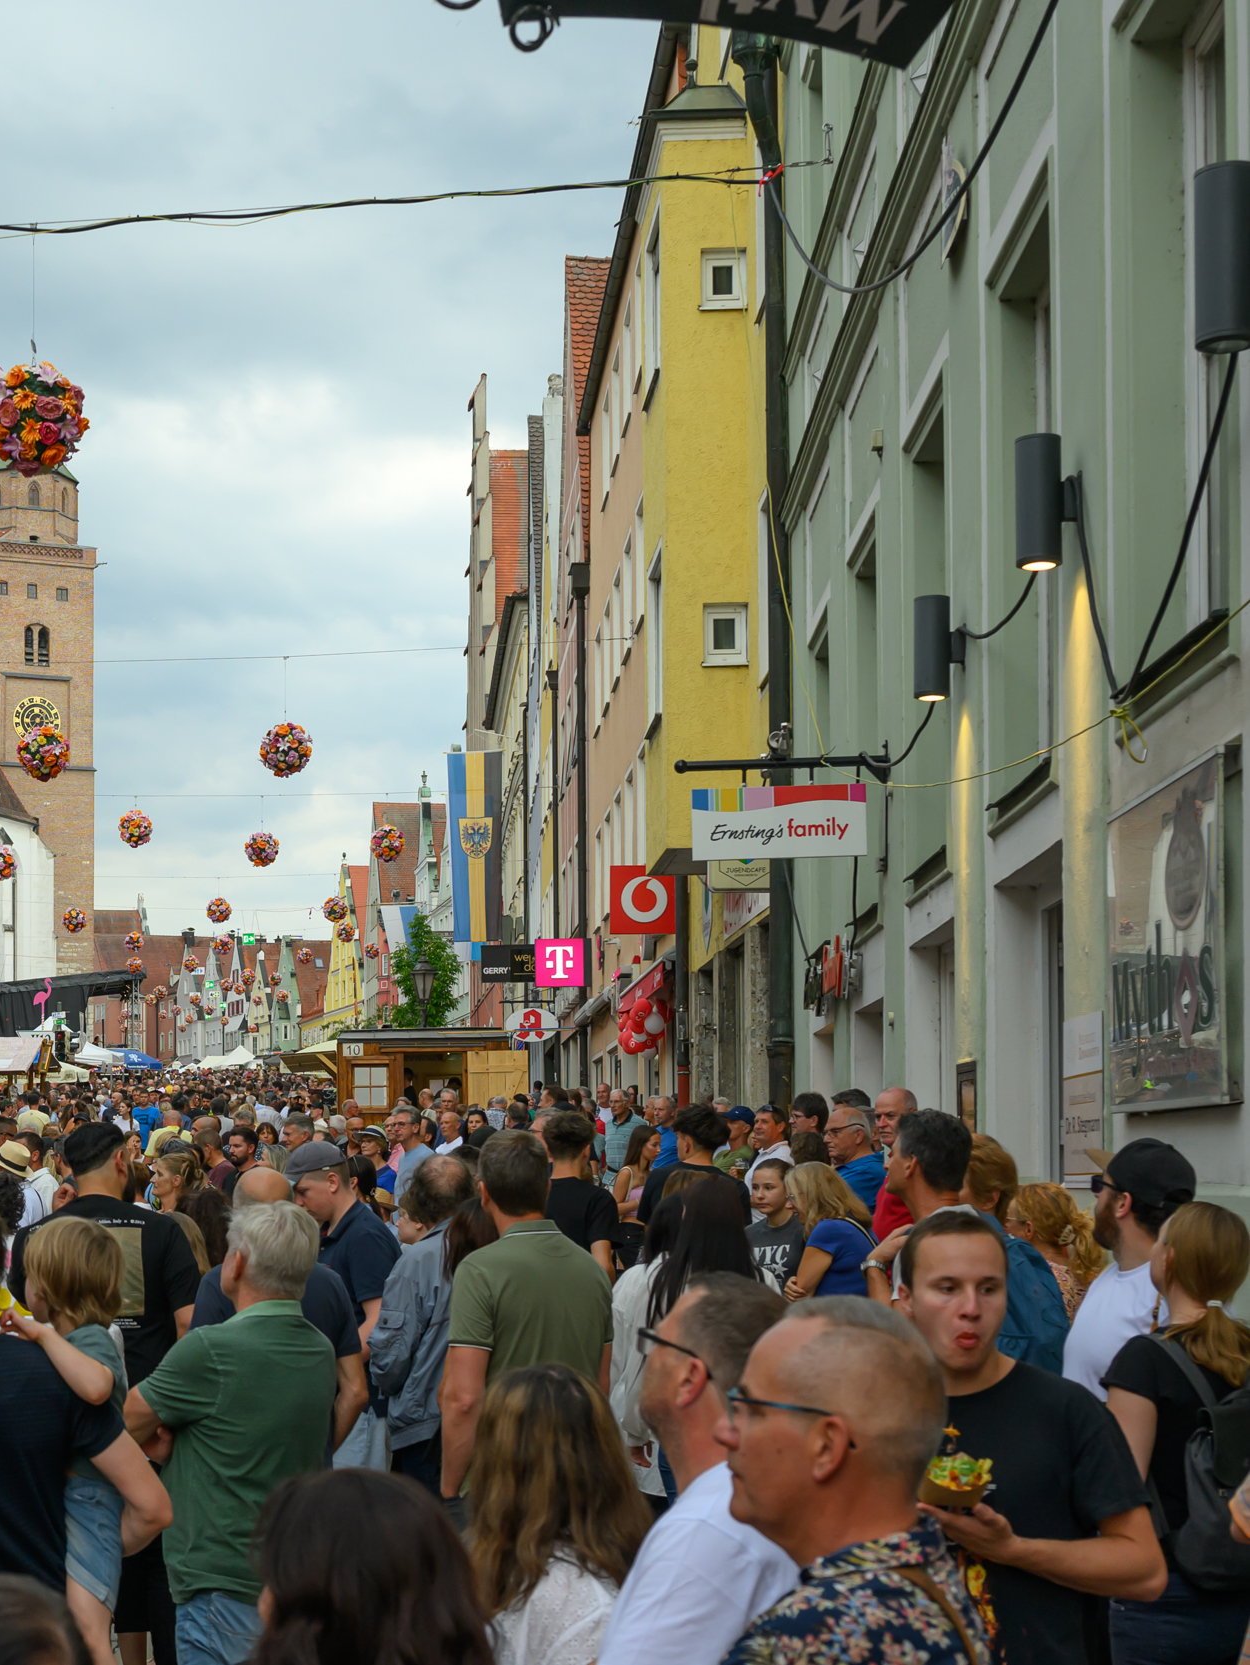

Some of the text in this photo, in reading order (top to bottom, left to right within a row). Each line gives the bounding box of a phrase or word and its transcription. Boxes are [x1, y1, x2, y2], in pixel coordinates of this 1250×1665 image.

[710, 816, 849, 846] Ernsting's family
[726, 866, 767, 874] JUGENDCAFE
[346, 1044, 361, 1056] 10
